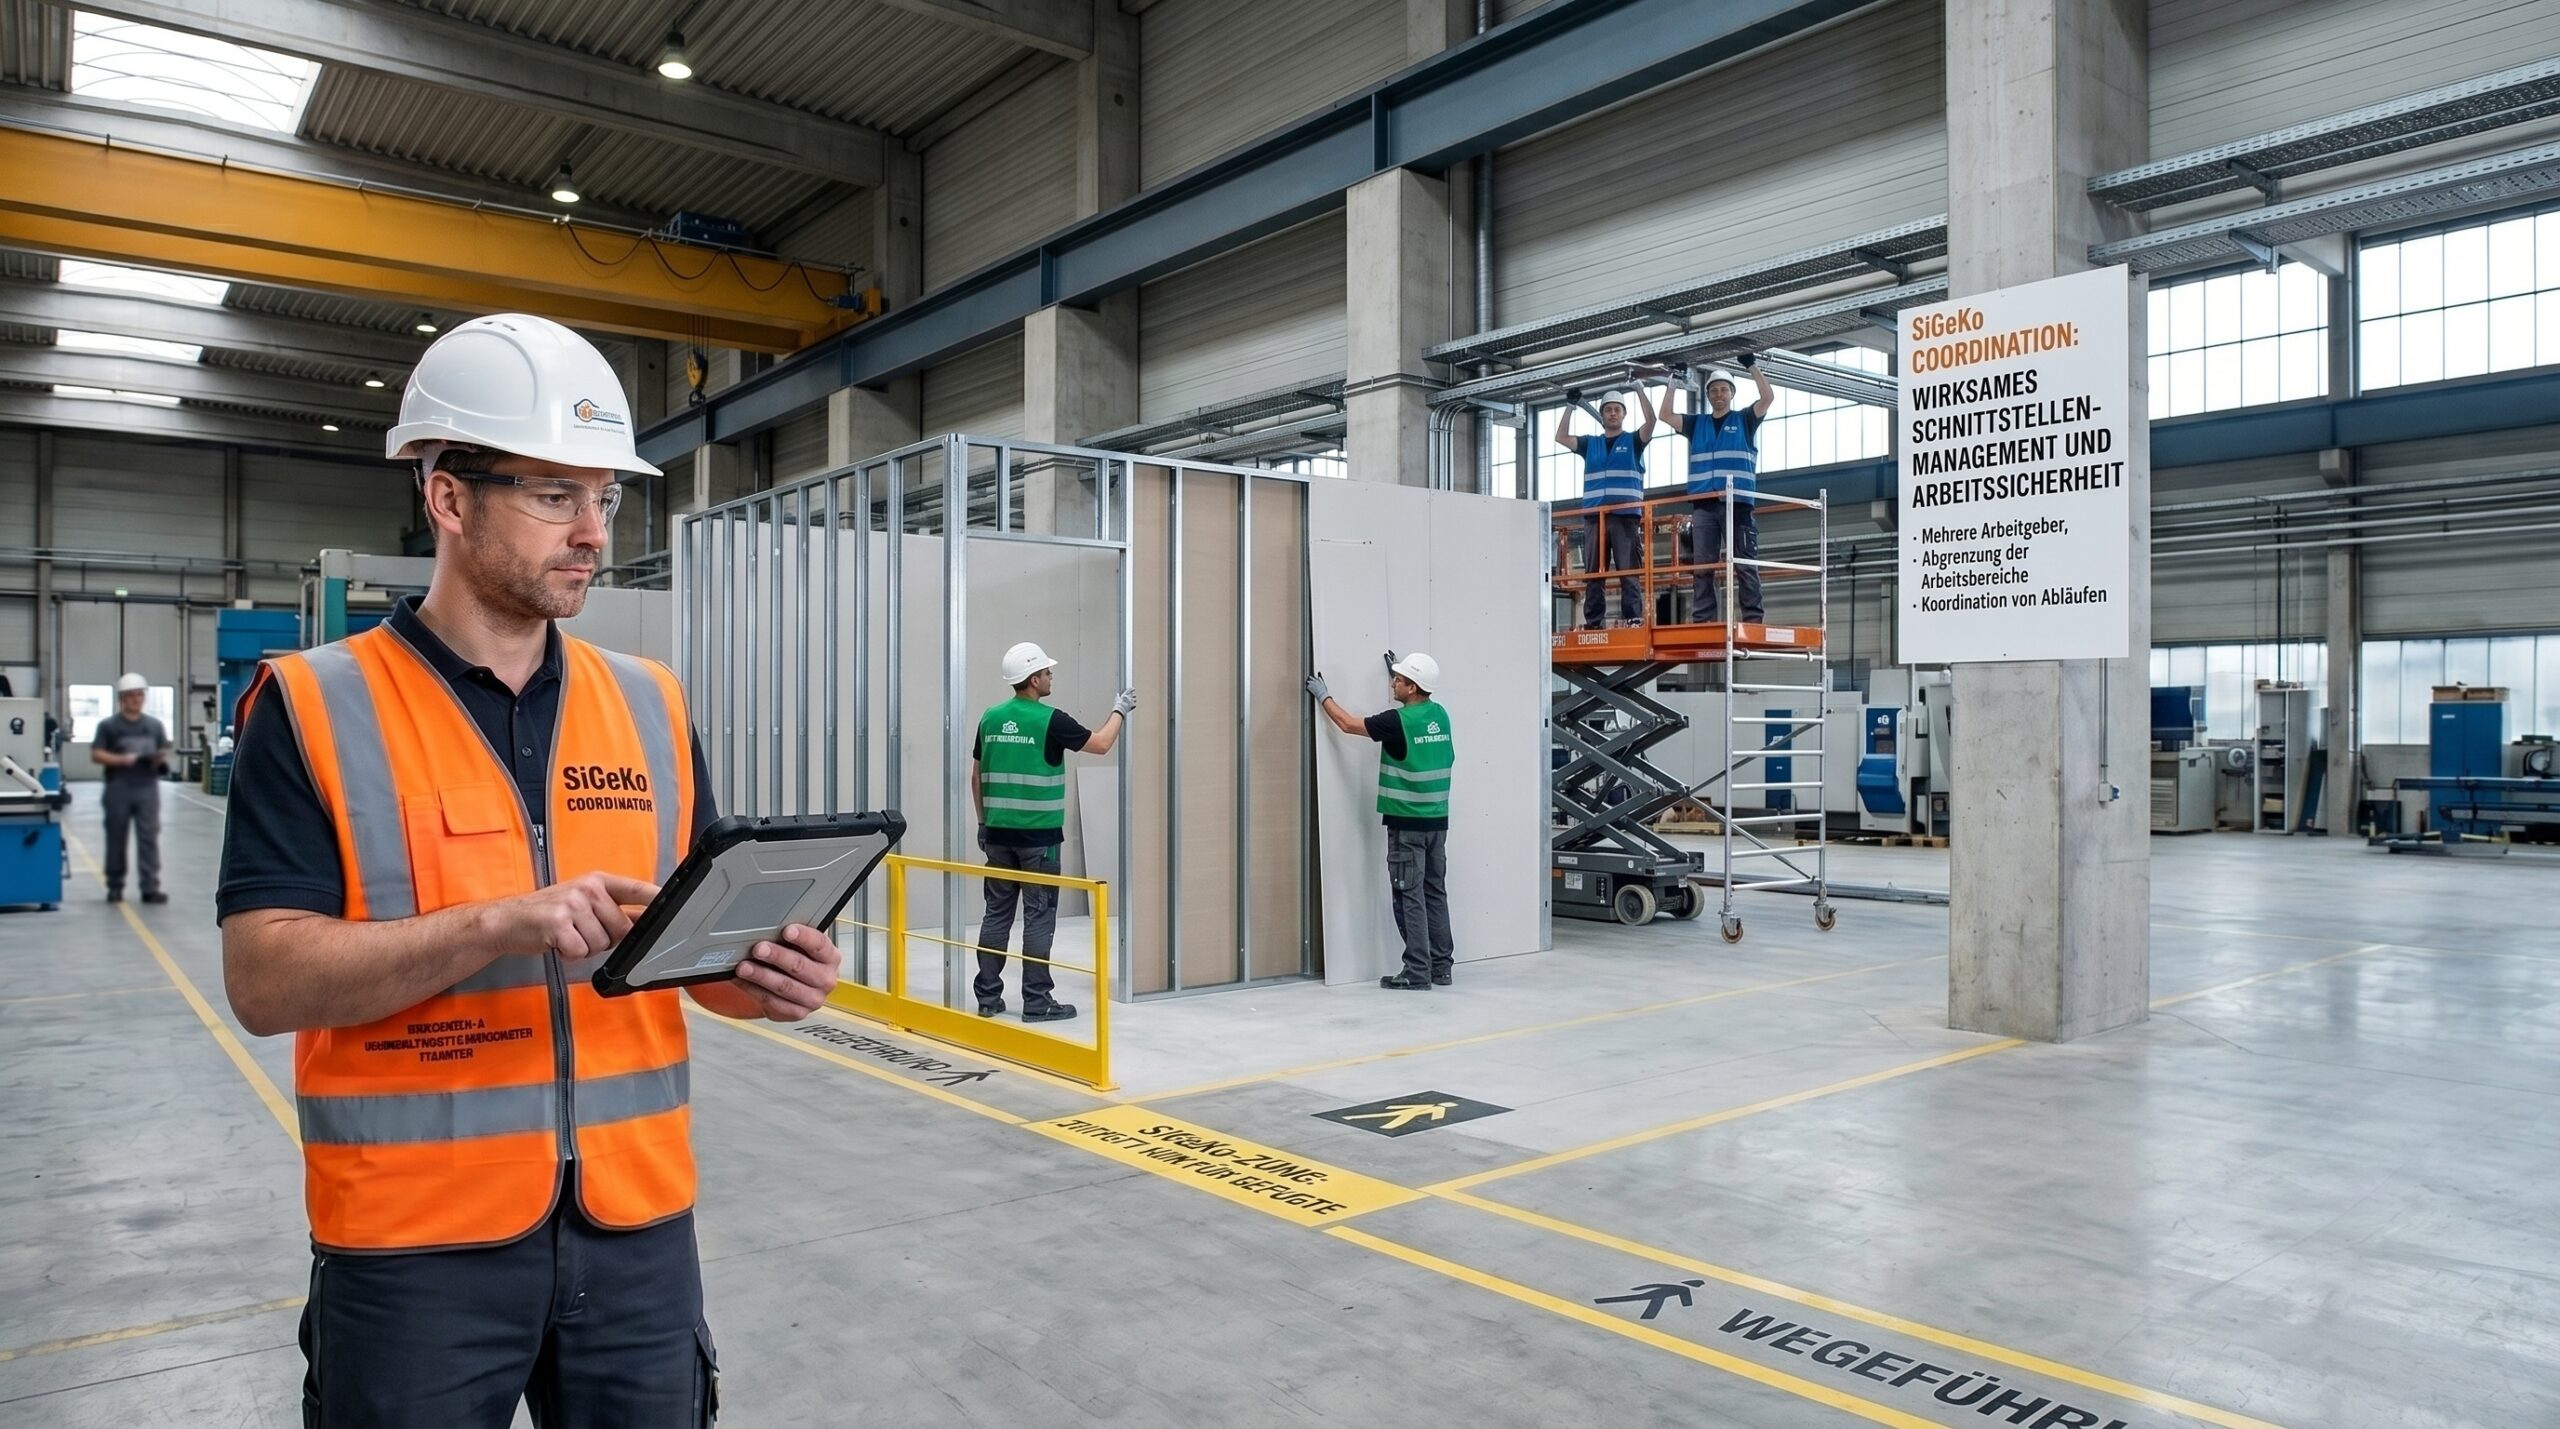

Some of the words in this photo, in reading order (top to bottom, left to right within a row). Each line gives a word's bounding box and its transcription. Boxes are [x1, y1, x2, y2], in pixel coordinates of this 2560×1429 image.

[1912, 307, 1984, 341] SiGeKo
[1912, 322, 2079, 374] COORDINATION:
[1912, 369, 2038, 411] WIRKSAMES
[1912, 395, 2102, 444] SCHNITTSTELLEN-
[1912, 435, 2058, 477] MANAGEMENT
[2065, 428, 2112, 457] UND
[1912, 461, 2124, 508] ARBEITSSICHERHEIT
[1922, 525, 1977, 544] Mehrere
[1981, 517, 2069, 540] Arbeitgeber,
[1922, 547, 2002, 570] Abgrenzung
[2006, 543, 2030, 561] der
[1921, 566, 2029, 590] Arbeitsbereiche
[1922, 592, 2007, 613] Koordination
[2012, 593, 2037, 608] von
[2041, 586, 2107, 606] Abläufen
[562, 765, 648, 793] SiGeKo
[567, 796, 653, 812] COORDINATOR
[1718, 1307, 2129, 1429] WEGEFÜHR
